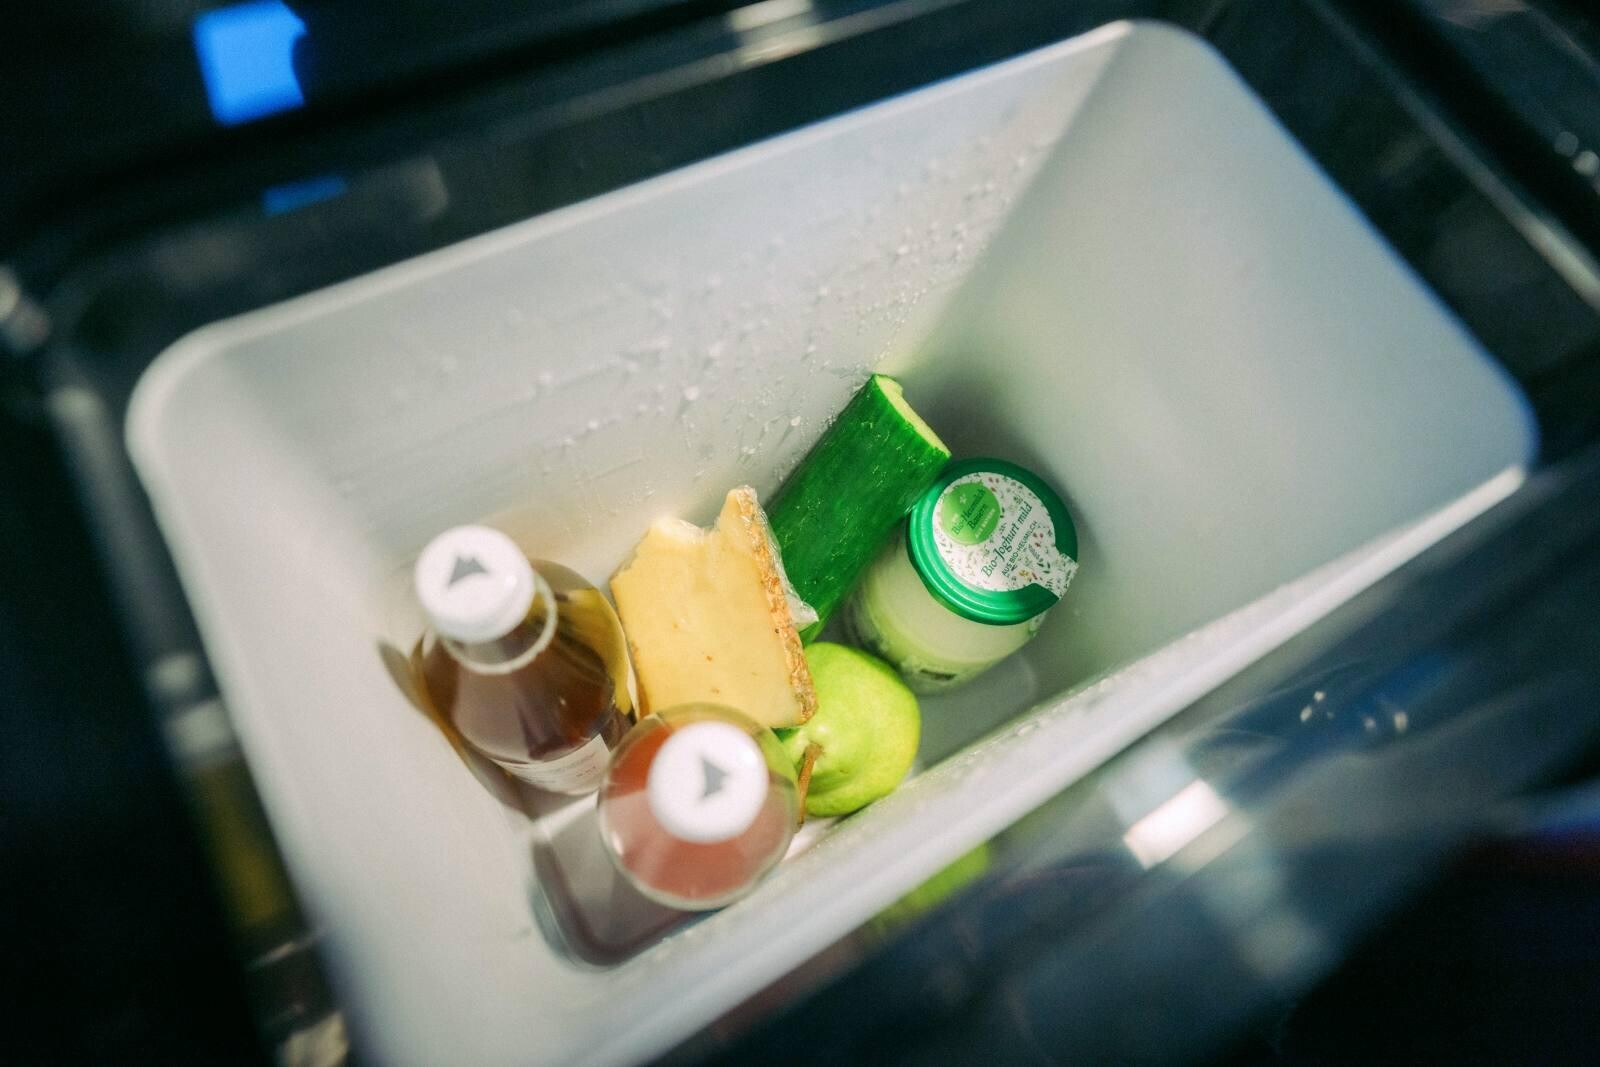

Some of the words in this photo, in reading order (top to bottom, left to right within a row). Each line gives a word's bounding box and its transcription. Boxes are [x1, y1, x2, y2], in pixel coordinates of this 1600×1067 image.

[981, 522, 1020, 578] Bio-Joghurt
[1018, 501, 1033, 526] mild
[1001, 563, 1013, 577] AUS
[1009, 521, 1038, 566] BIO-HEUMILCH
